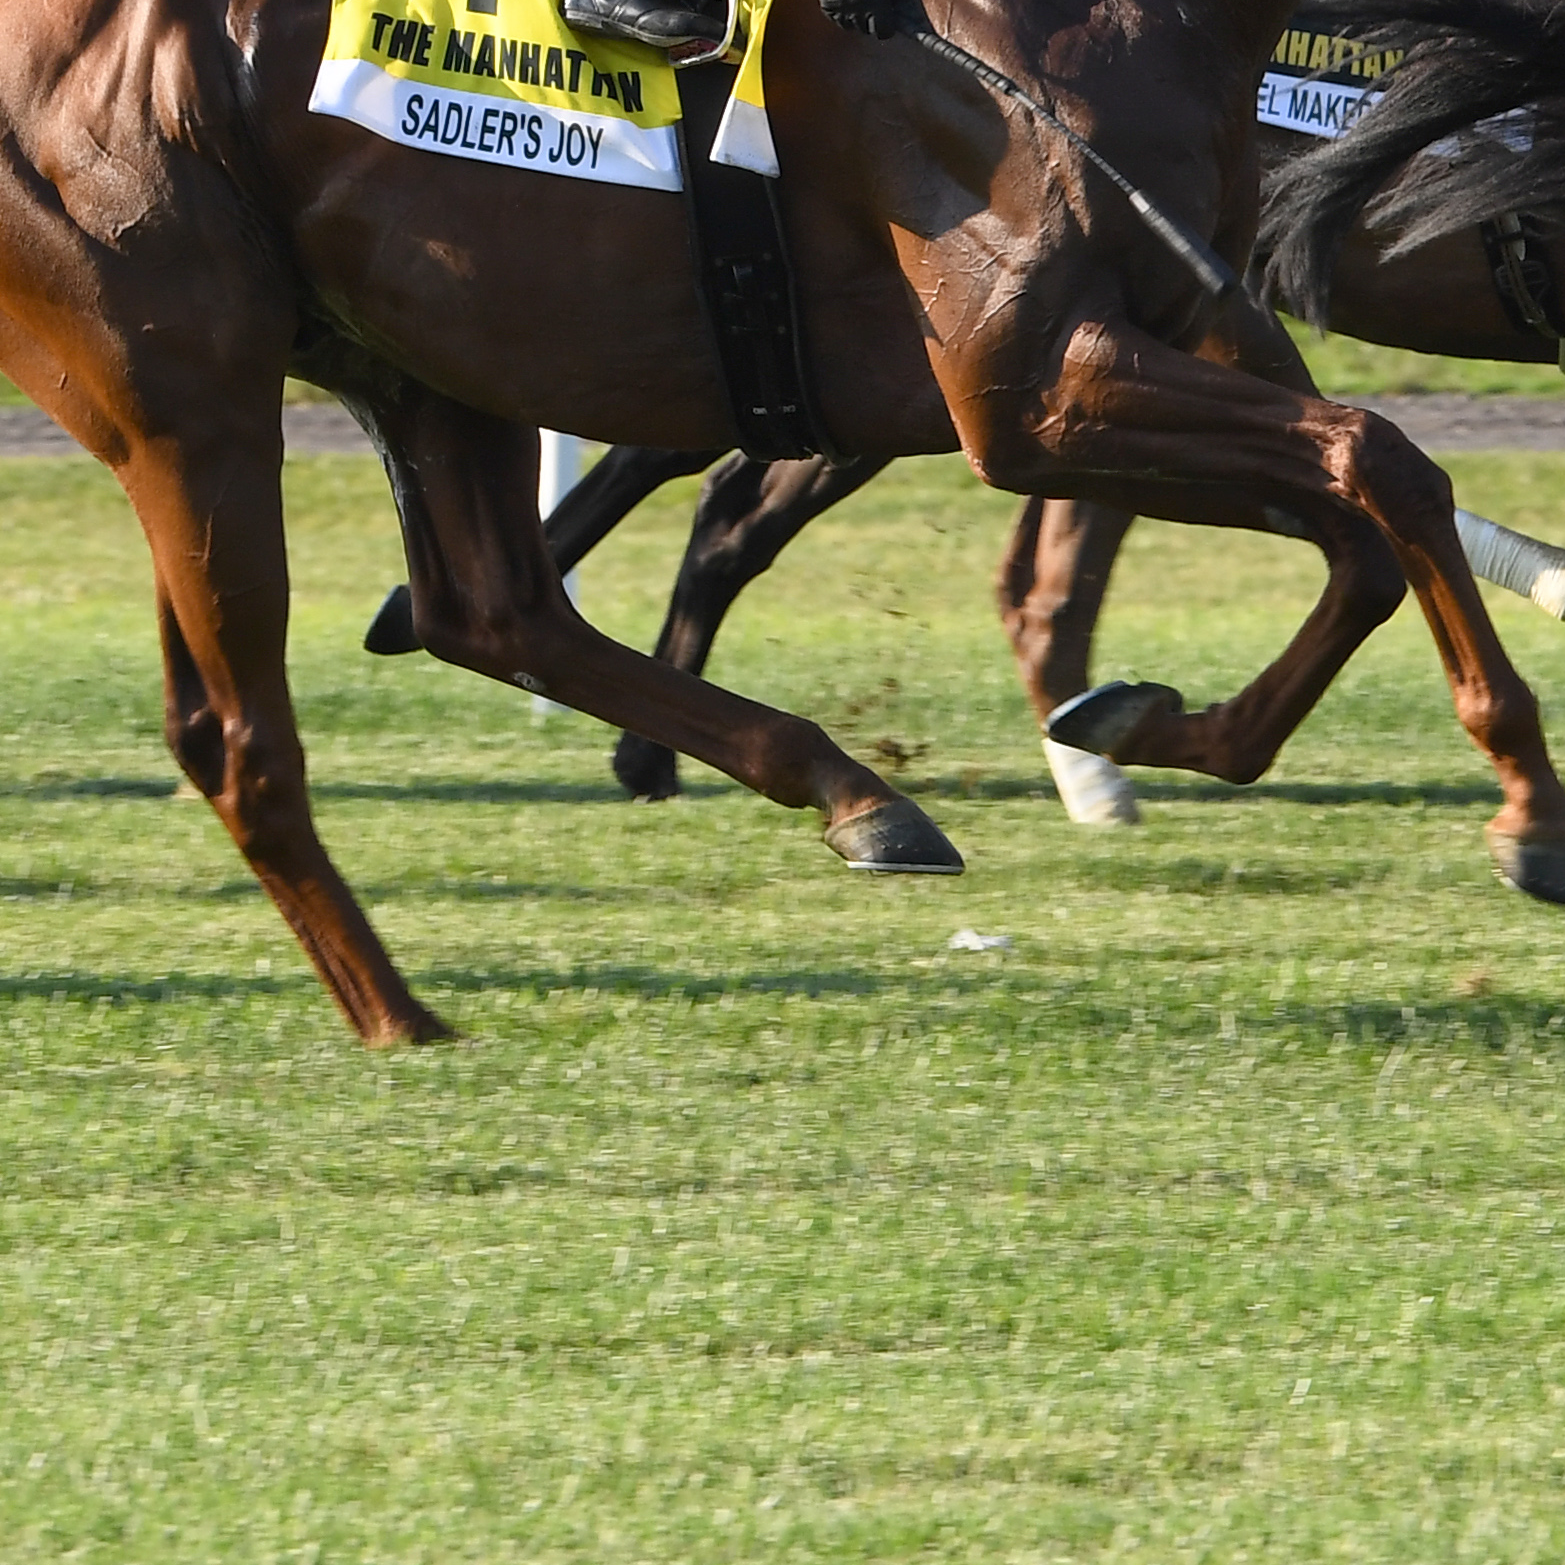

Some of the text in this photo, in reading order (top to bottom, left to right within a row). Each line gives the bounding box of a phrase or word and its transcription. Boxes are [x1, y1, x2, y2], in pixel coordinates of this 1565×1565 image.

[371, 12, 645, 113] THE MANHATAN
[401, 94, 604, 170] SADLER'S JOY
